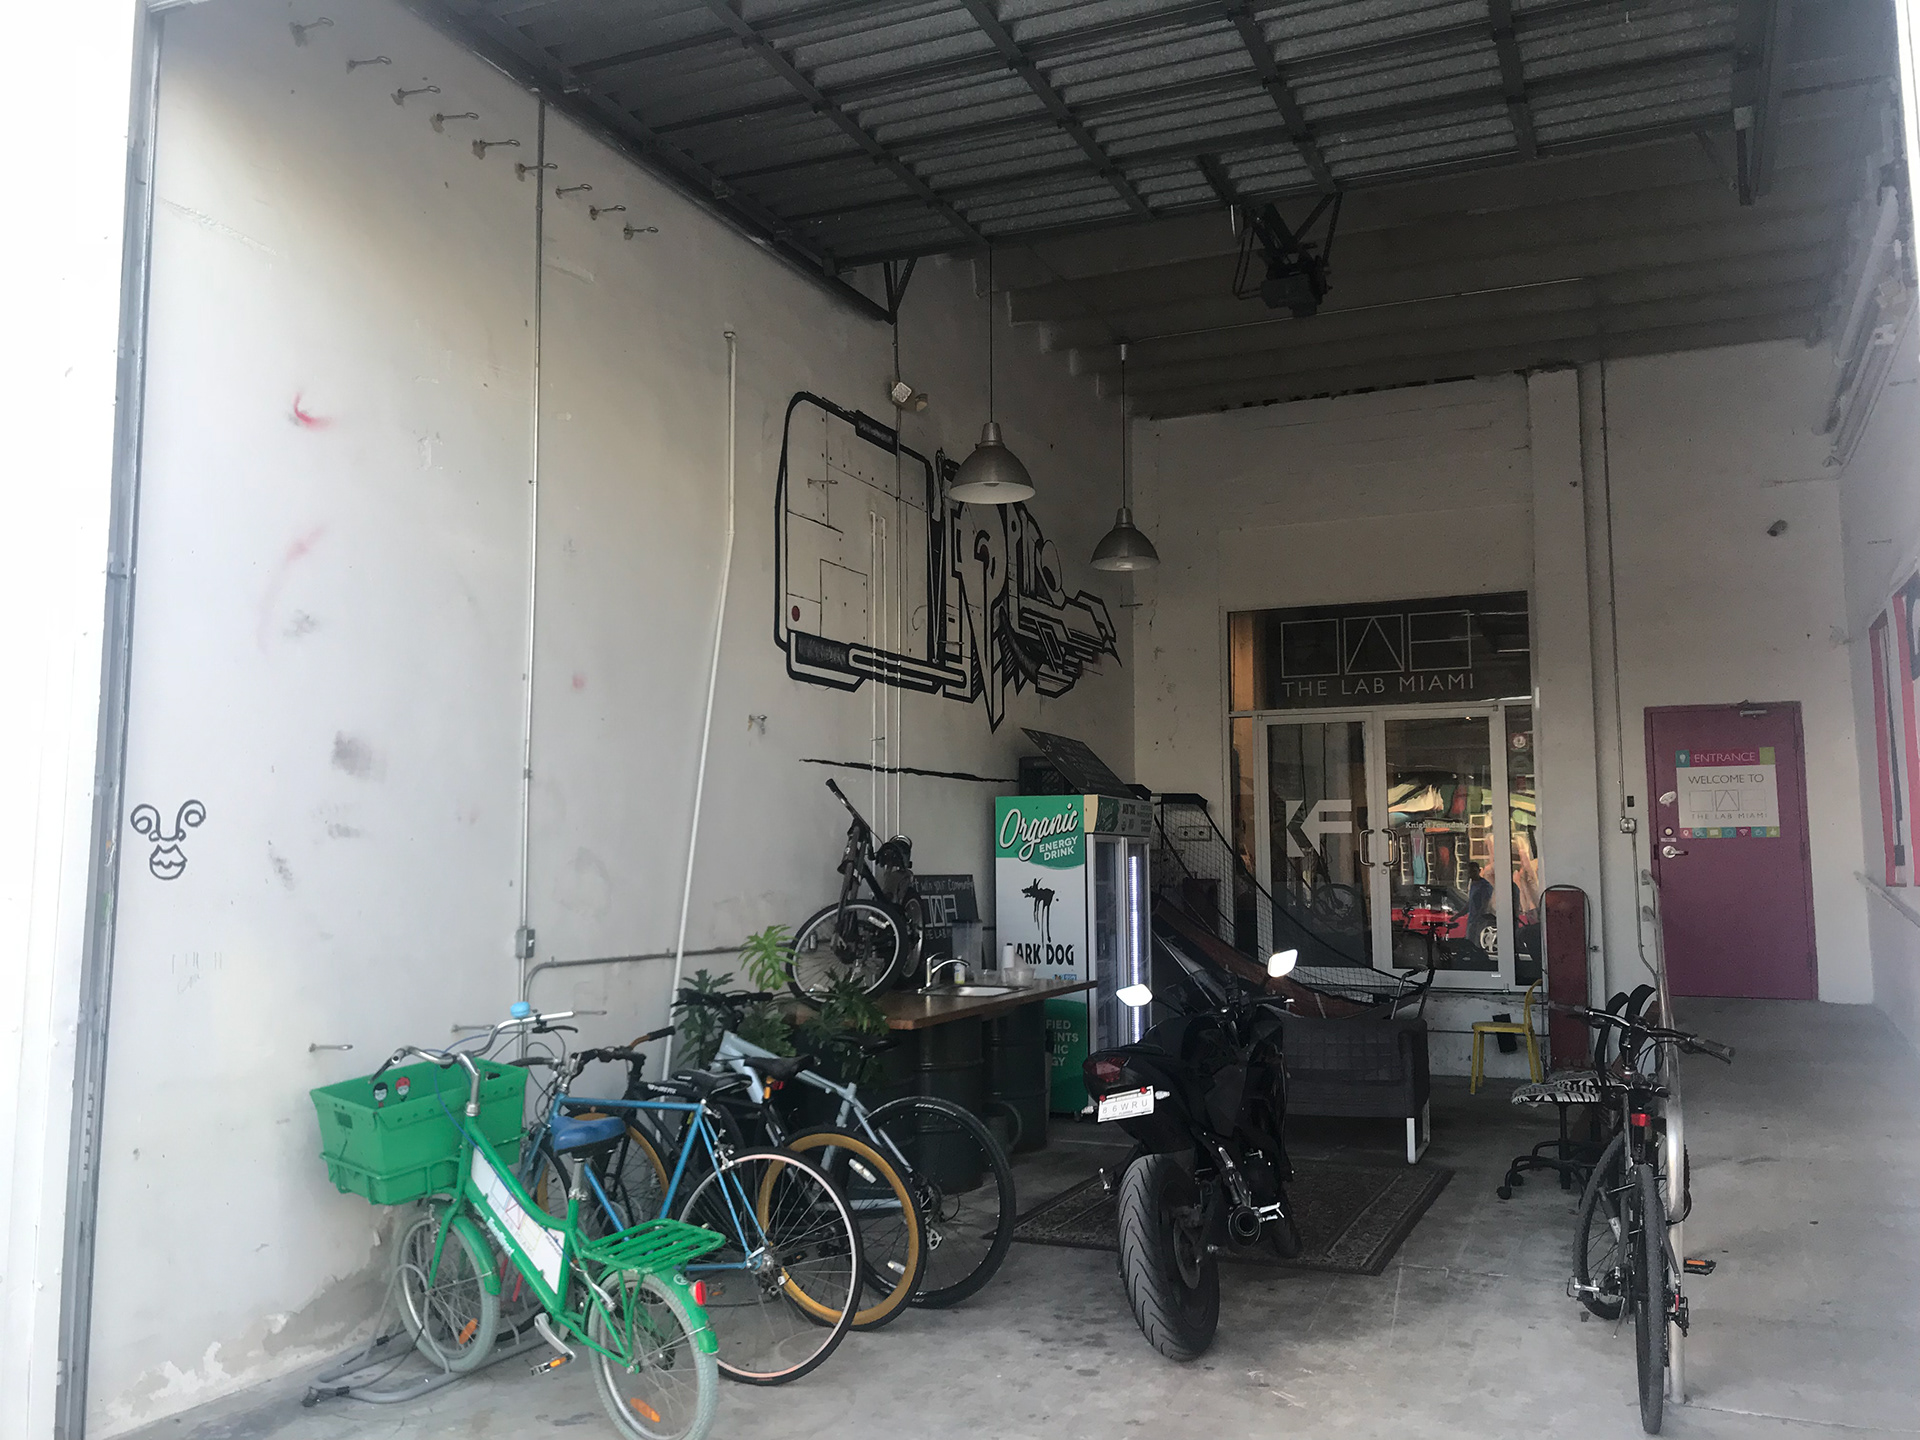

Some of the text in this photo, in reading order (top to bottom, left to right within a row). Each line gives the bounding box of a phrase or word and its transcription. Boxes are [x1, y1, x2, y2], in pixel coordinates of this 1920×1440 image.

[1282, 673, 1475, 698] THE LAB MIAMI
[1693, 752, 1756, 763] ENTRANCE
[1688, 773, 1765, 784] WELCOME TO
[1405, 821, 1429, 830] Knight
[999, 803, 1079, 862] Organic
[1039, 836, 1078, 853] ENERGY
[1043, 846, 1075, 861] DRINK
[1006, 943, 1075, 966] ARK DOG
[1045, 1020, 1071, 1030] FIED
[1054, 1032, 1079, 1043] NTS
[1051, 1057, 1066, 1066] GY
